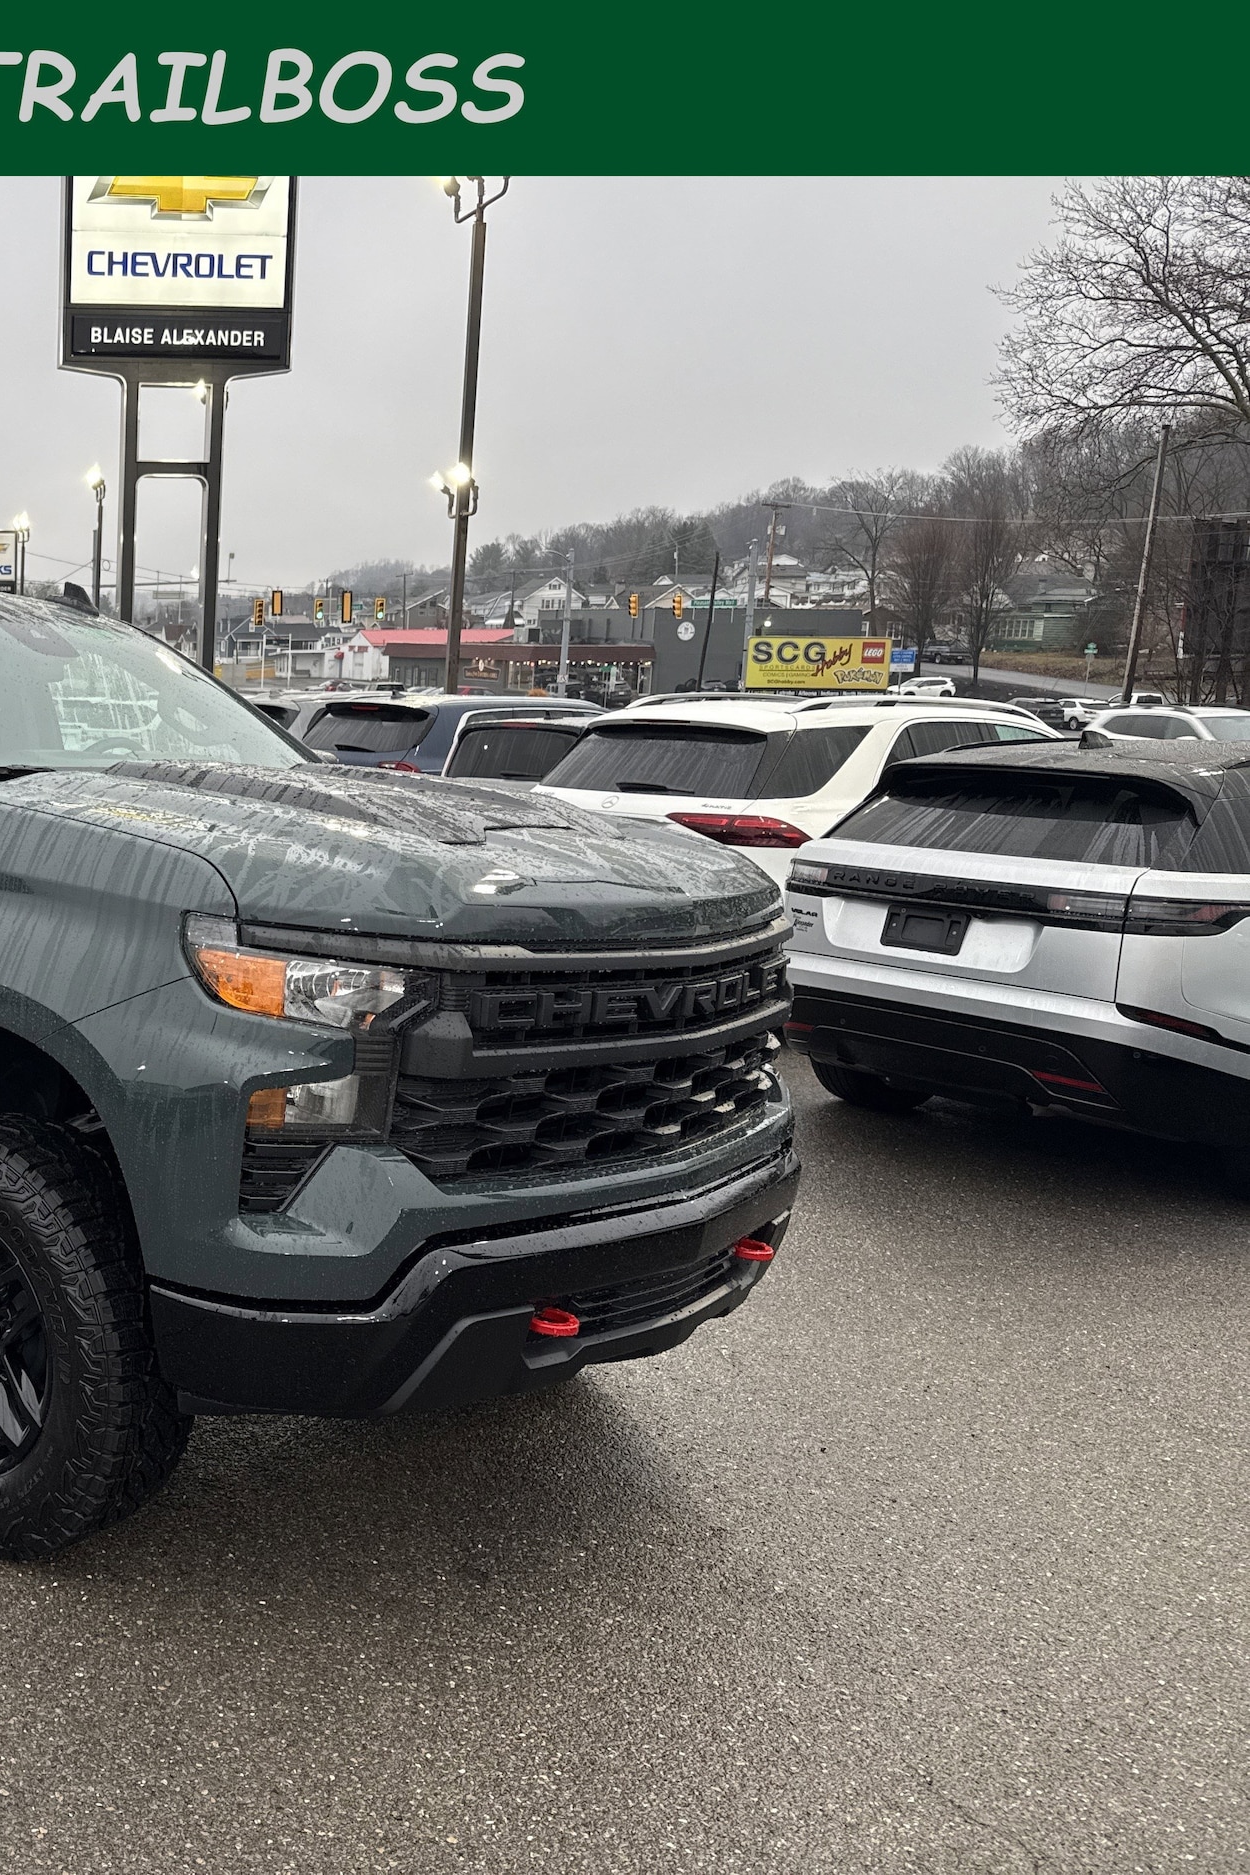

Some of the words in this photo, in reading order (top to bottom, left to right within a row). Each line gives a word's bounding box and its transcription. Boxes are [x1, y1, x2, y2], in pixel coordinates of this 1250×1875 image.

[87, 250, 273, 279] CHEVROLET
[90, 327, 154, 344] BLAISE
[160, 328, 265, 346] ALEXANDER
[752, 641, 826, 664] SCG
[811, 643, 853, 677] Hobby
[864, 648, 883, 657] LEGO
[833, 870, 917, 890] RANGE
